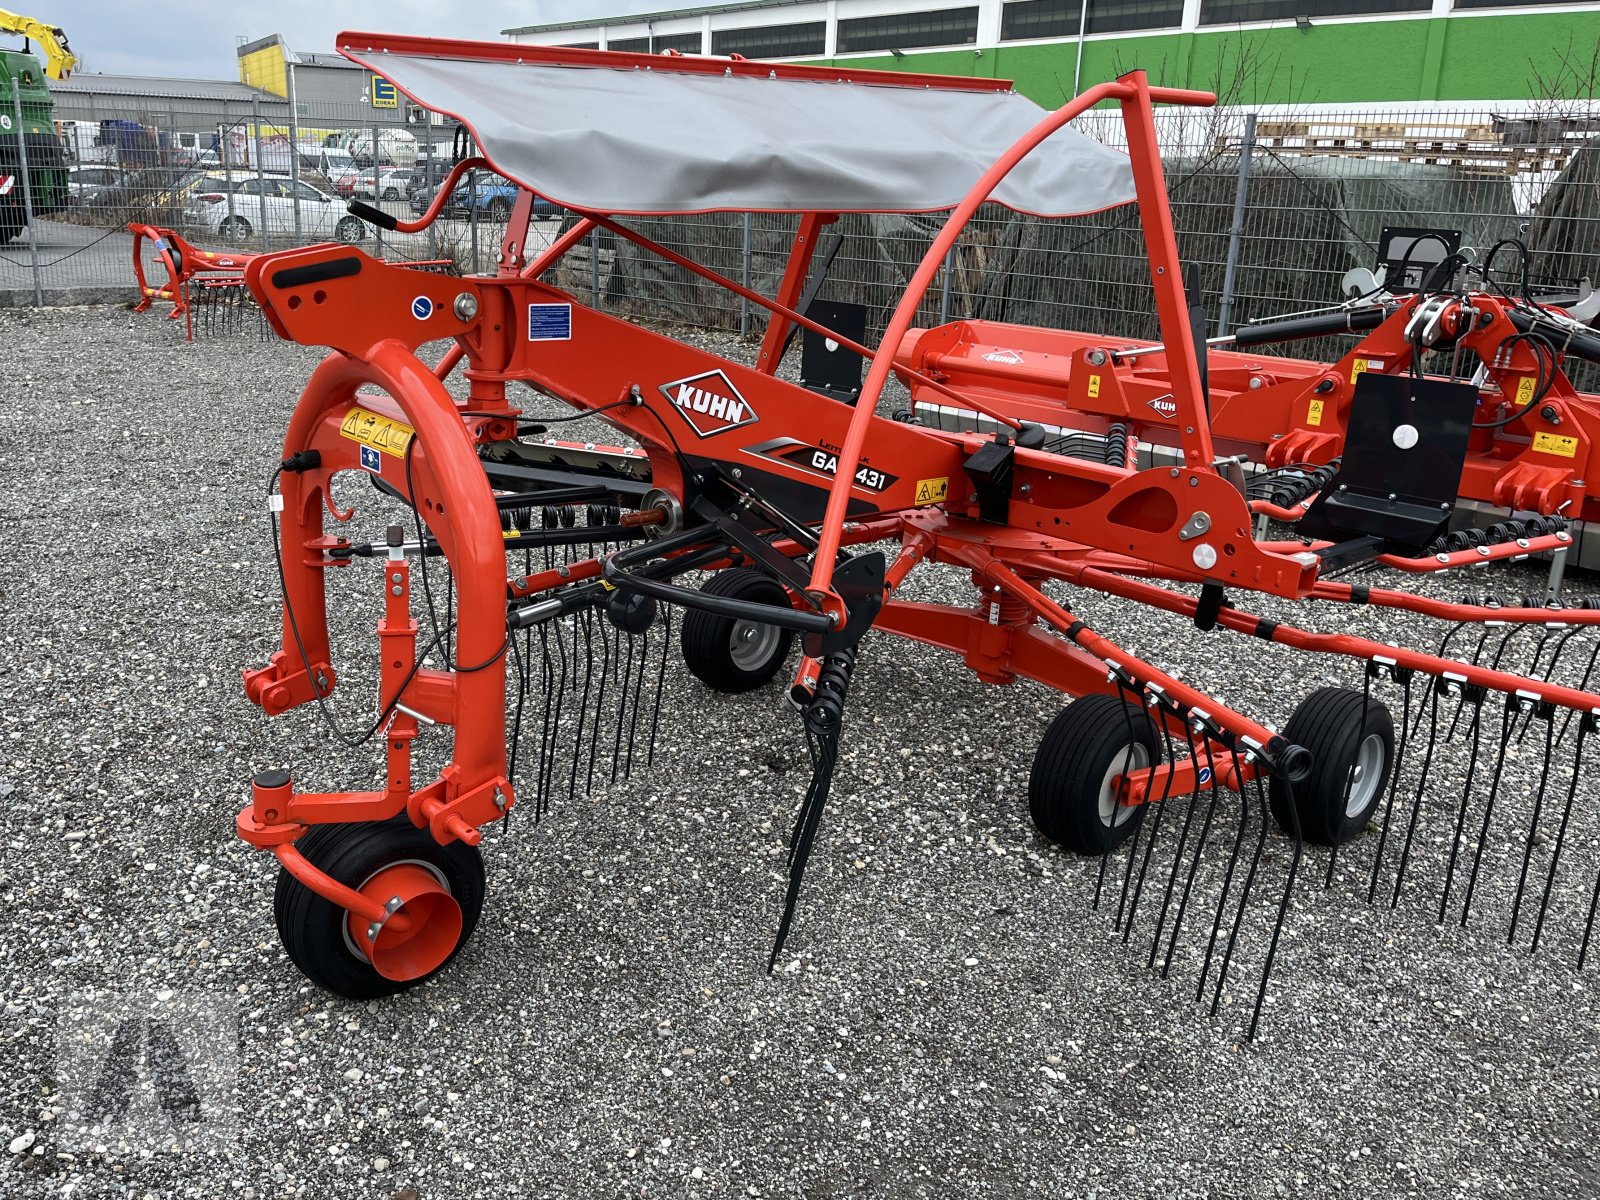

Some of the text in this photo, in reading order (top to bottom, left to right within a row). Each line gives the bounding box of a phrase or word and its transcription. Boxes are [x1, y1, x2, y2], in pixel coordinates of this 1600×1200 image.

[987, 353, 1016, 365] KUHN
[676, 383, 744, 424] KUHN
[1154, 400, 1176, 412] KUH
